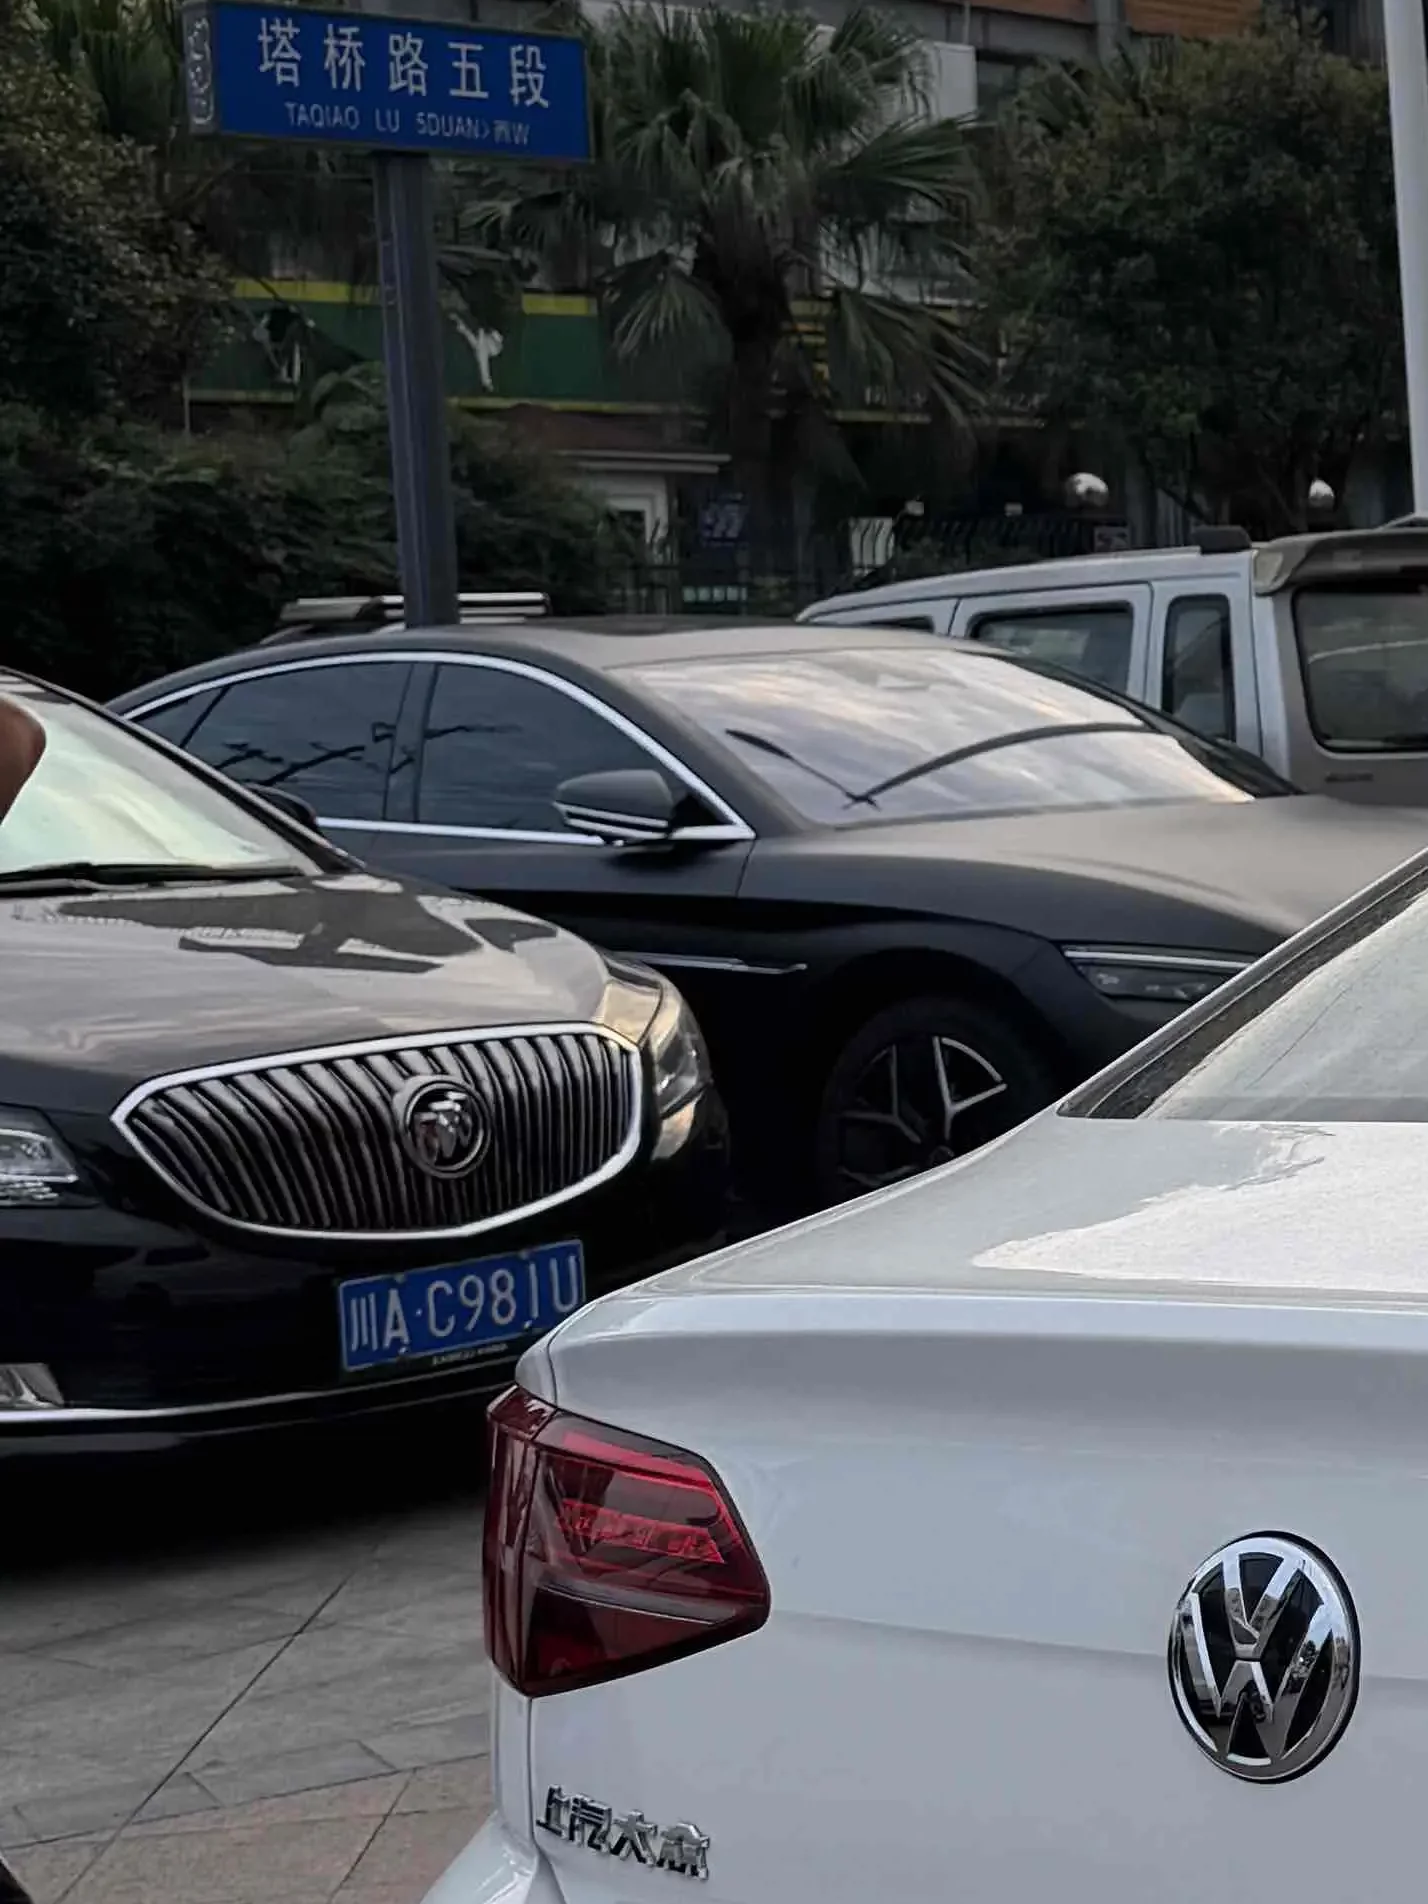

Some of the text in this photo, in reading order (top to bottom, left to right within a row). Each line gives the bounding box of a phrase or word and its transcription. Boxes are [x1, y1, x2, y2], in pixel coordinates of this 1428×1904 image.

[258, 17, 550, 109] 塔桥路五段
[284, 101, 361, 131] TAQIAO
[375, 109, 401, 133] LU
